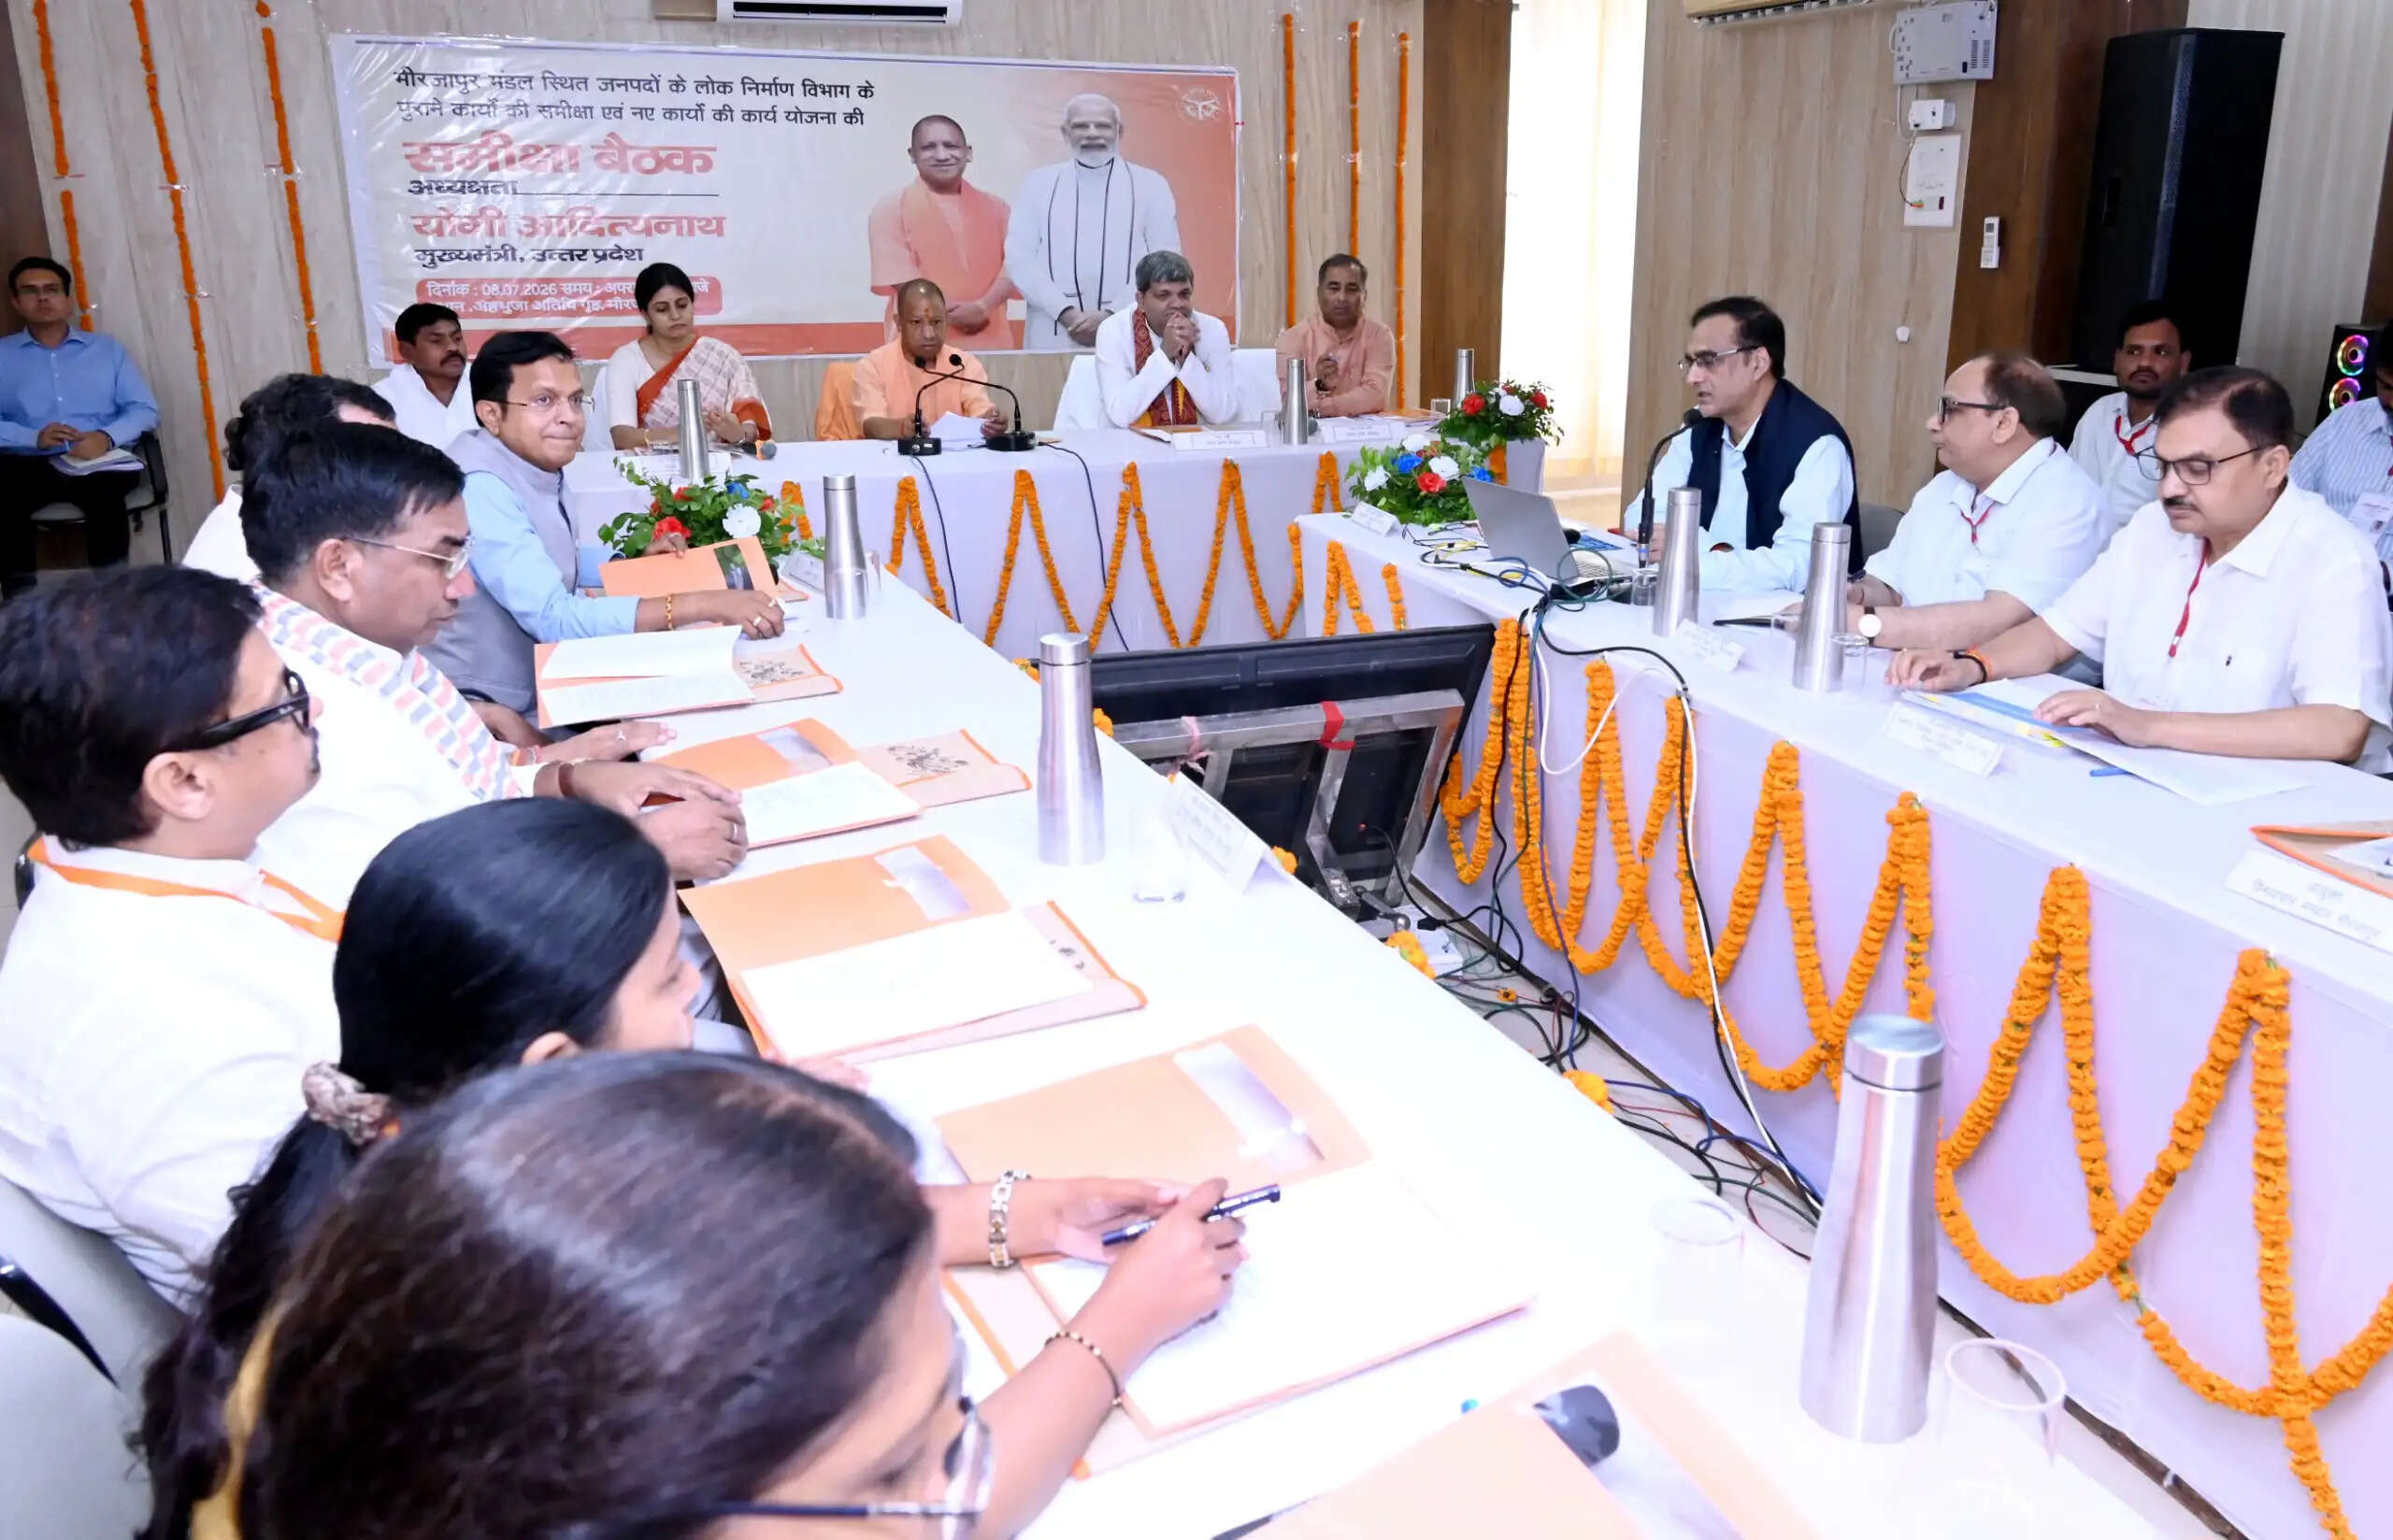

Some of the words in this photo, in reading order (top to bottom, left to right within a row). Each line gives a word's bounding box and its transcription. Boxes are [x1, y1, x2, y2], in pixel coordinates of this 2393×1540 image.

[395, 66, 480, 94] मीरजापुर
[488, 70, 534, 91] मंडल
[541, 70, 589, 92] स्थित
[596, 74, 661, 93] जनपदों
[667, 74, 687, 94] के
[694, 75, 734, 95] लोक
[740, 77, 795, 97] निर्माण
[801, 78, 851, 99] विभाग
[856, 79, 875, 99] के
[396, 97, 444, 121] पुराने
[450, 97, 499, 118] कार्यों
[505, 100, 530, 119] की
[537, 100, 595, 120] समीक्षा
[601, 102, 625, 121] एवं
[630, 106, 655, 121] नए
[662, 103, 707, 122] कार्यों
[712, 104, 734, 122] की
[740, 105, 778, 123] कार्य
[784, 106, 837, 124] योजना
[843, 107, 865, 125] की
[402, 129, 581, 174] समीक्षा
[591, 131, 717, 175] बैठक
[408, 180, 518, 195] अध्यक्षता
[410, 206, 509, 237] योगी
[517, 206, 727, 237] आदित्यनाथ
[531, 248, 589, 263] उत्तर
[590, 244, 643, 264] प्रदेश
[425, 280, 470, 296] दिनांक
